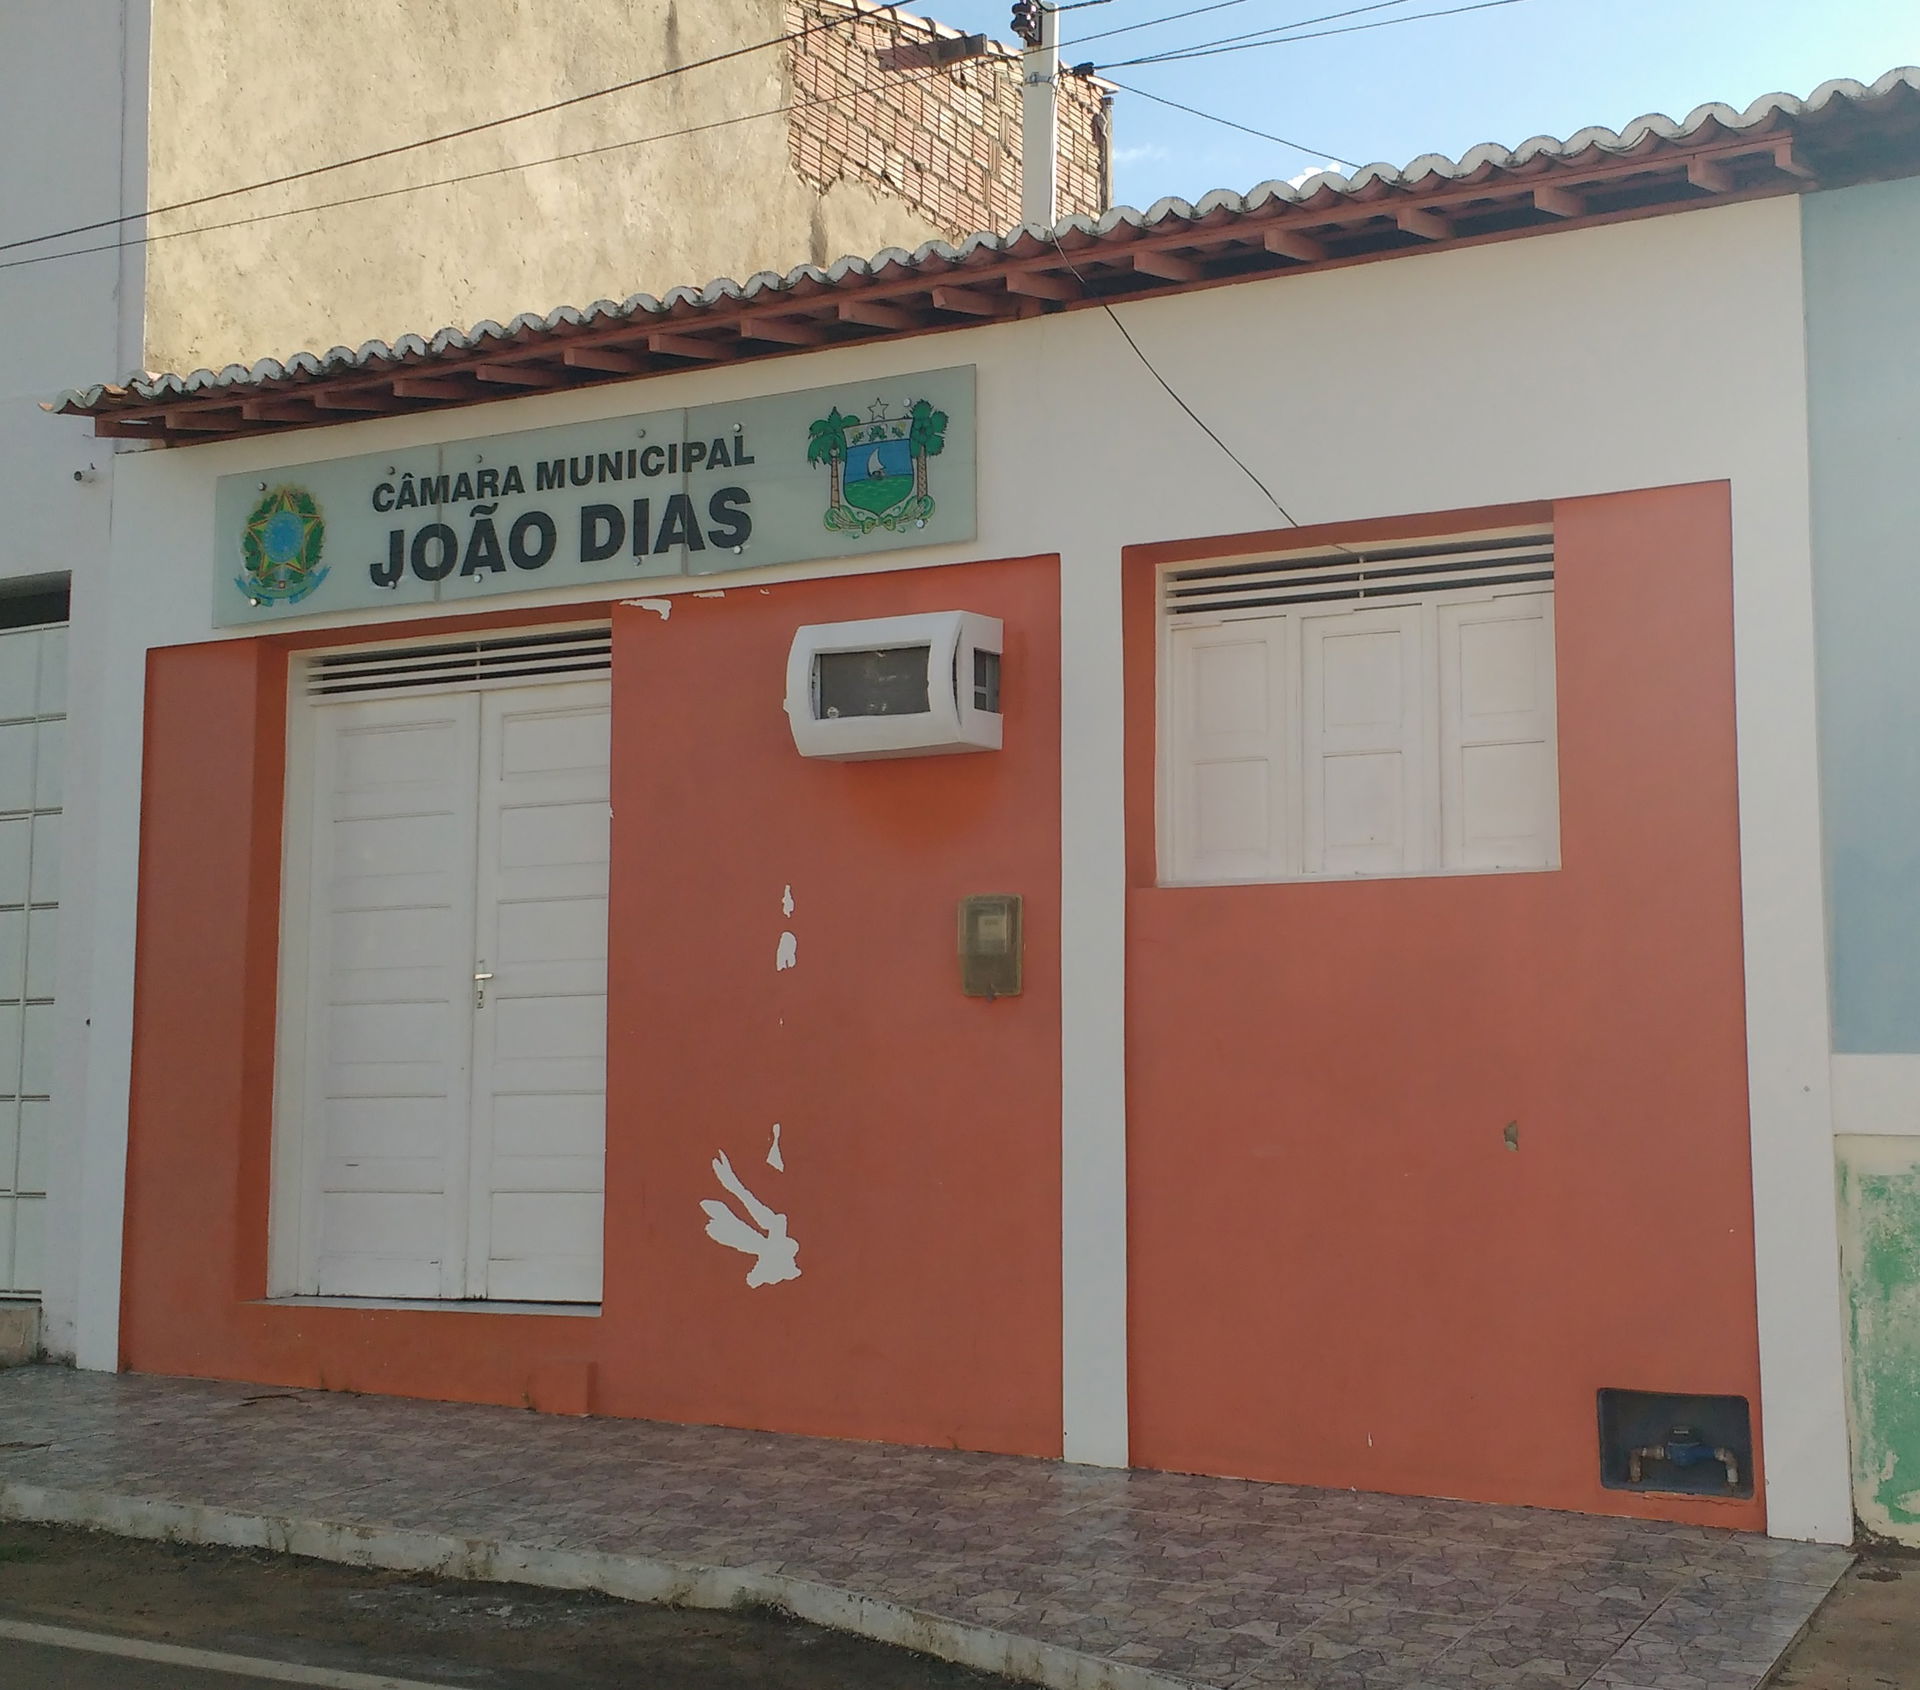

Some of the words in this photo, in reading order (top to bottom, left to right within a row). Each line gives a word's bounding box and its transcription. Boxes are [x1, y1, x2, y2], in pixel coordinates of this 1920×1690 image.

[372, 465, 525, 513] CÂMARA
[536, 435, 755, 492] MUNICIPAL
[370, 502, 557, 587] JOÃO
[580, 486, 752, 563] DIAS
